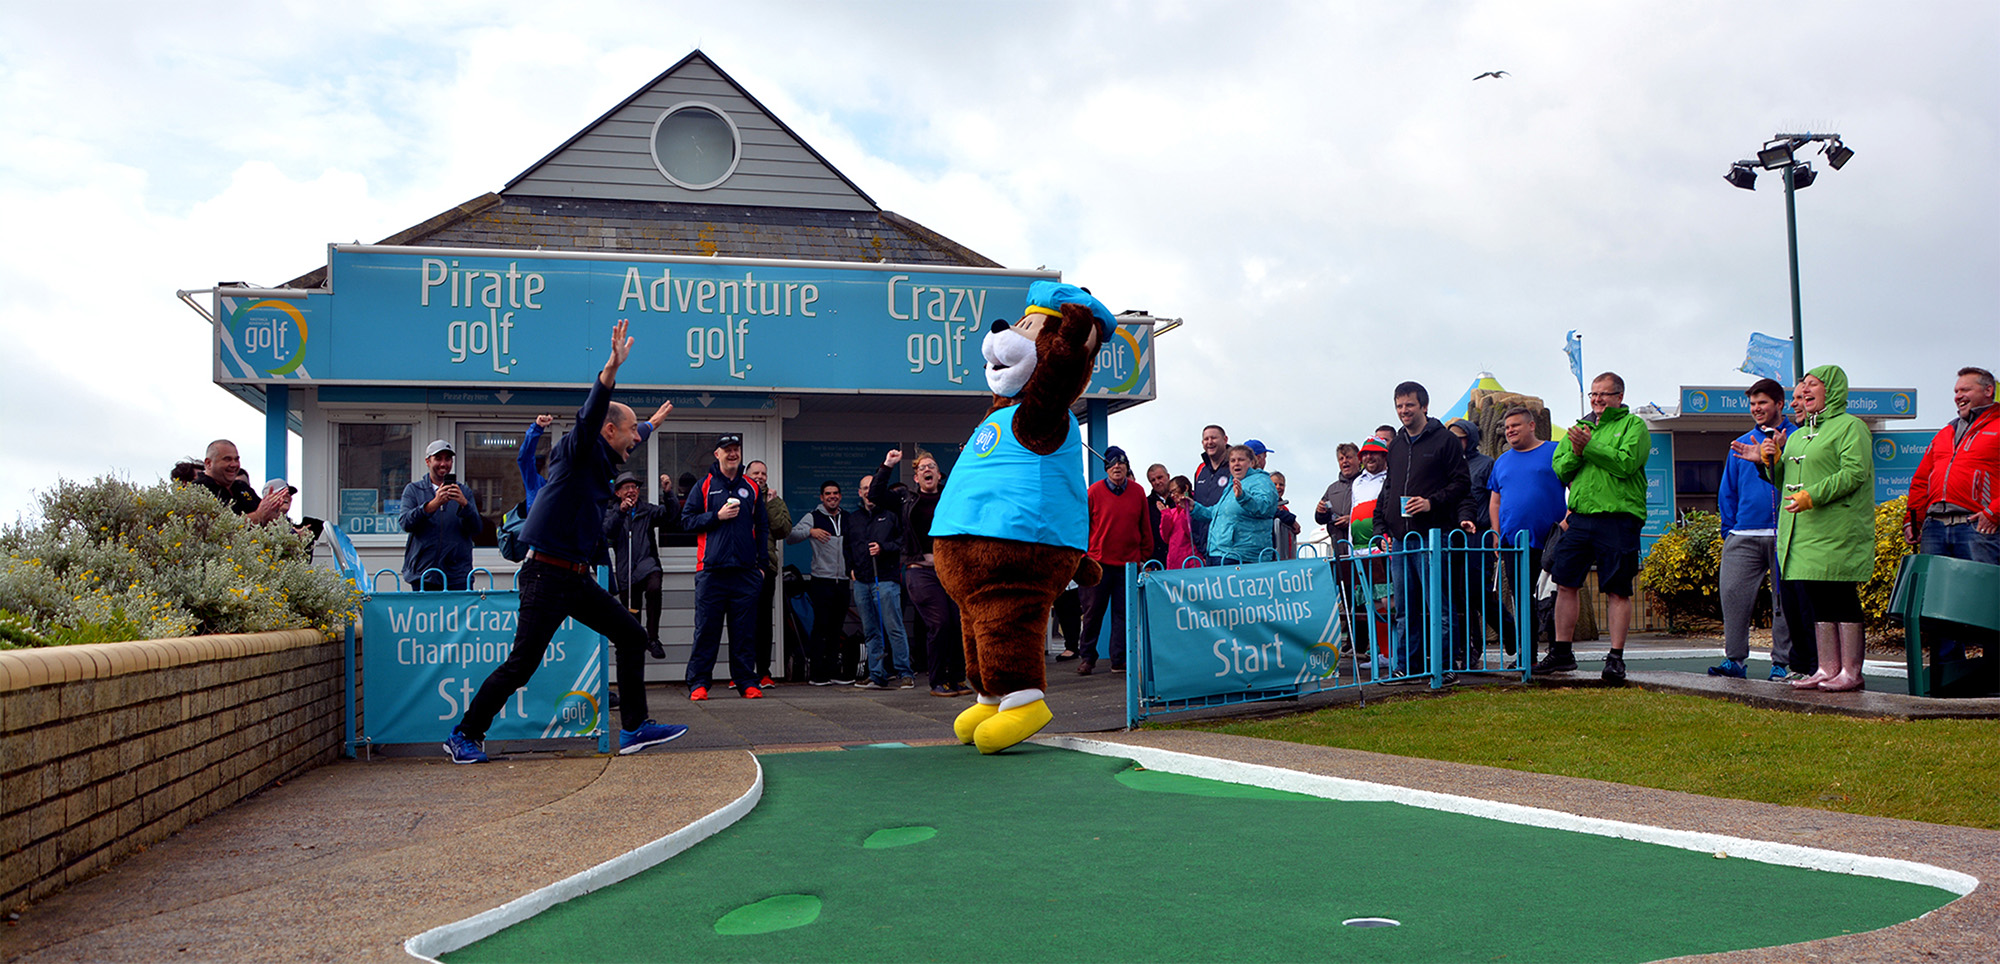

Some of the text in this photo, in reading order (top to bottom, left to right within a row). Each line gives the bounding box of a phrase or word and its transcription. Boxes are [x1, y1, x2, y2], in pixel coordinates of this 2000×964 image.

[421, 258, 546, 310] Pirate
[617, 266, 820, 318] Adventure
[887, 275, 987, 332] Crazy
[1720, 395, 1738, 408] The
[1846, 397, 1878, 411] onships
[1900, 444, 1926, 454] Welco
[1878, 477, 1889, 485] The
[1890, 476, 1909, 485] World
[350, 517, 398, 533] OPEN
[1163, 568, 1314, 604] World Crazy Golf
[388, 605, 459, 633] World
[1176, 598, 1313, 631] Championships
[397, 637, 566, 668] Championps
[1212, 633, 1286, 678] Start
[438, 677, 529, 721] Stt
